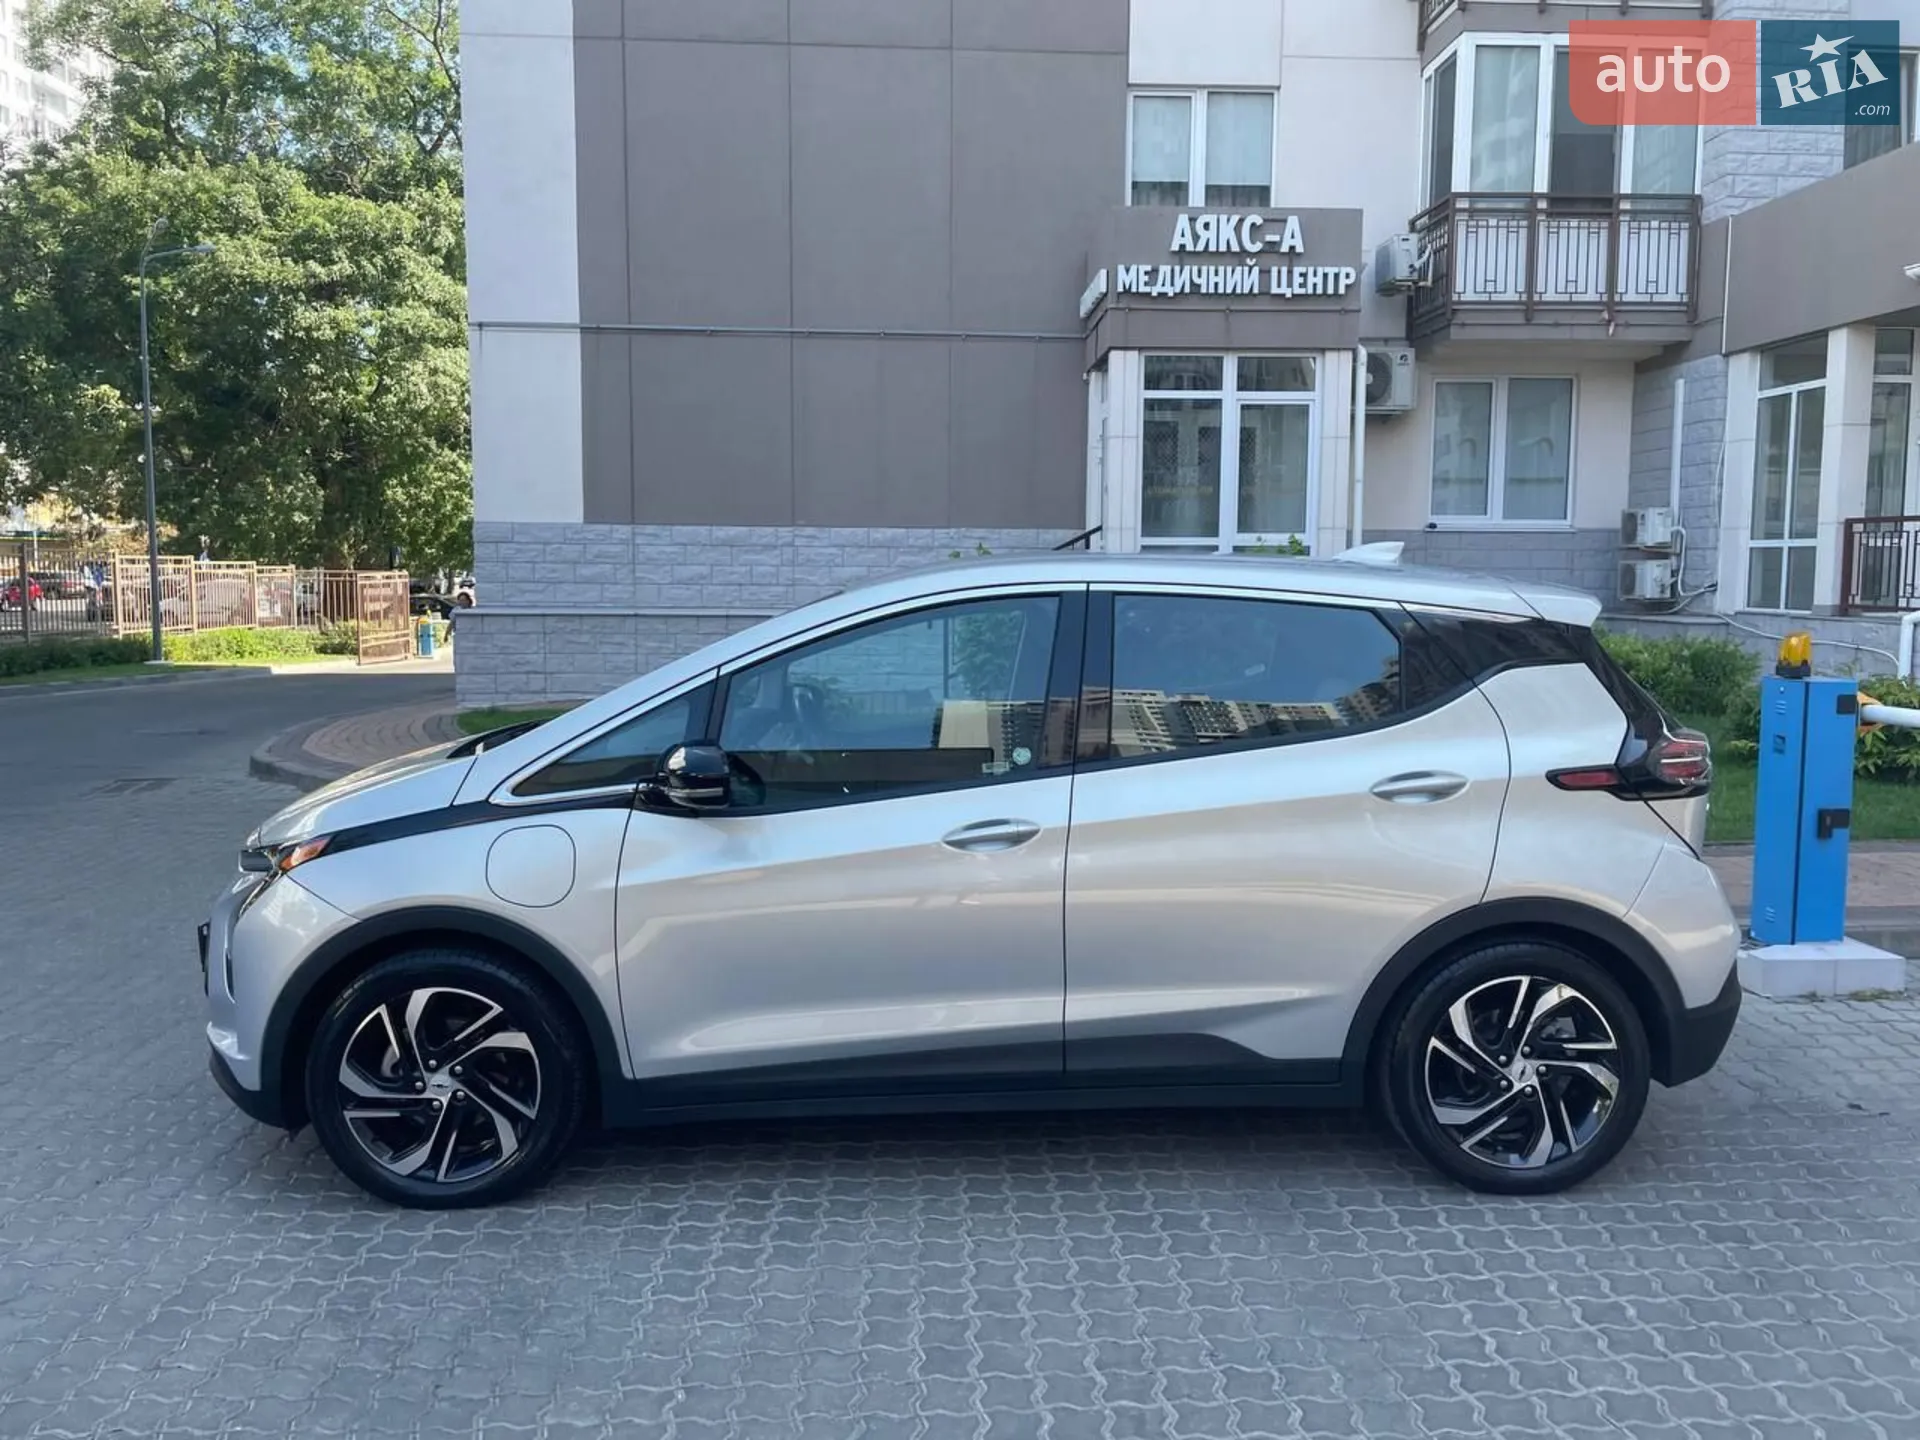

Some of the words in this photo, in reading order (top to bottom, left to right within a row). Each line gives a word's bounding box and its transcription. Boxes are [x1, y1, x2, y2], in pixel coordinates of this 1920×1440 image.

[1170, 214, 1304, 253] АЯКС-А
[1117, 258, 1260, 297] МЕДИЧНИЙ
[1270, 266, 1357, 298] ЦЕНТР
